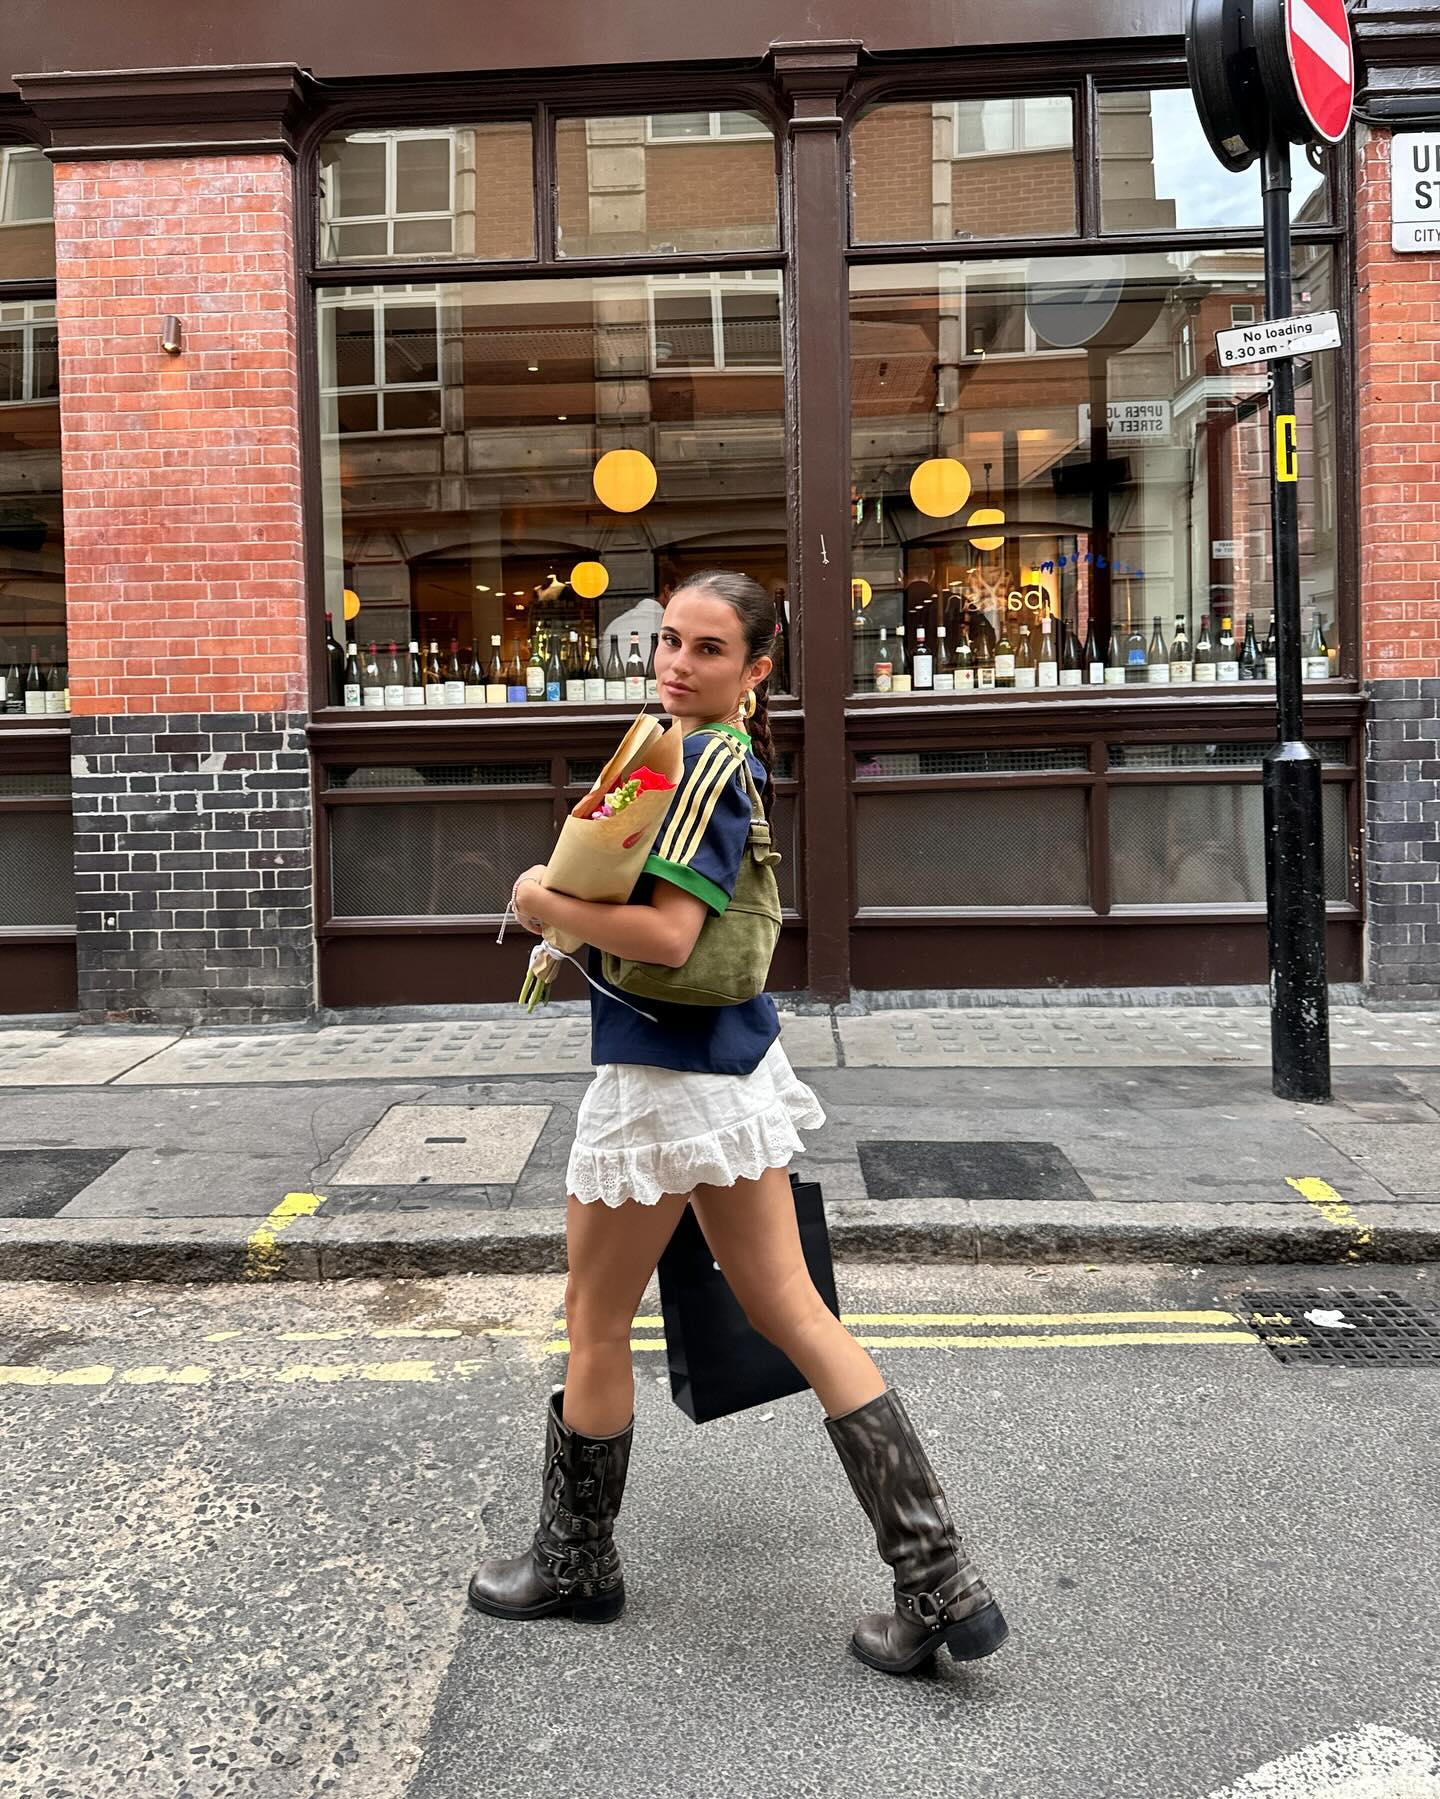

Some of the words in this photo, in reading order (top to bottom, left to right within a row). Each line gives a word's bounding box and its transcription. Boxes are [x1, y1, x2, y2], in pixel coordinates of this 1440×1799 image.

[1414, 229, 1440, 242] CITY
[1243, 332, 1262, 343] No
[1266, 323, 1313, 339] loading
[1225, 346, 1256, 361] 8.30
[1258, 344, 1278, 355] am
